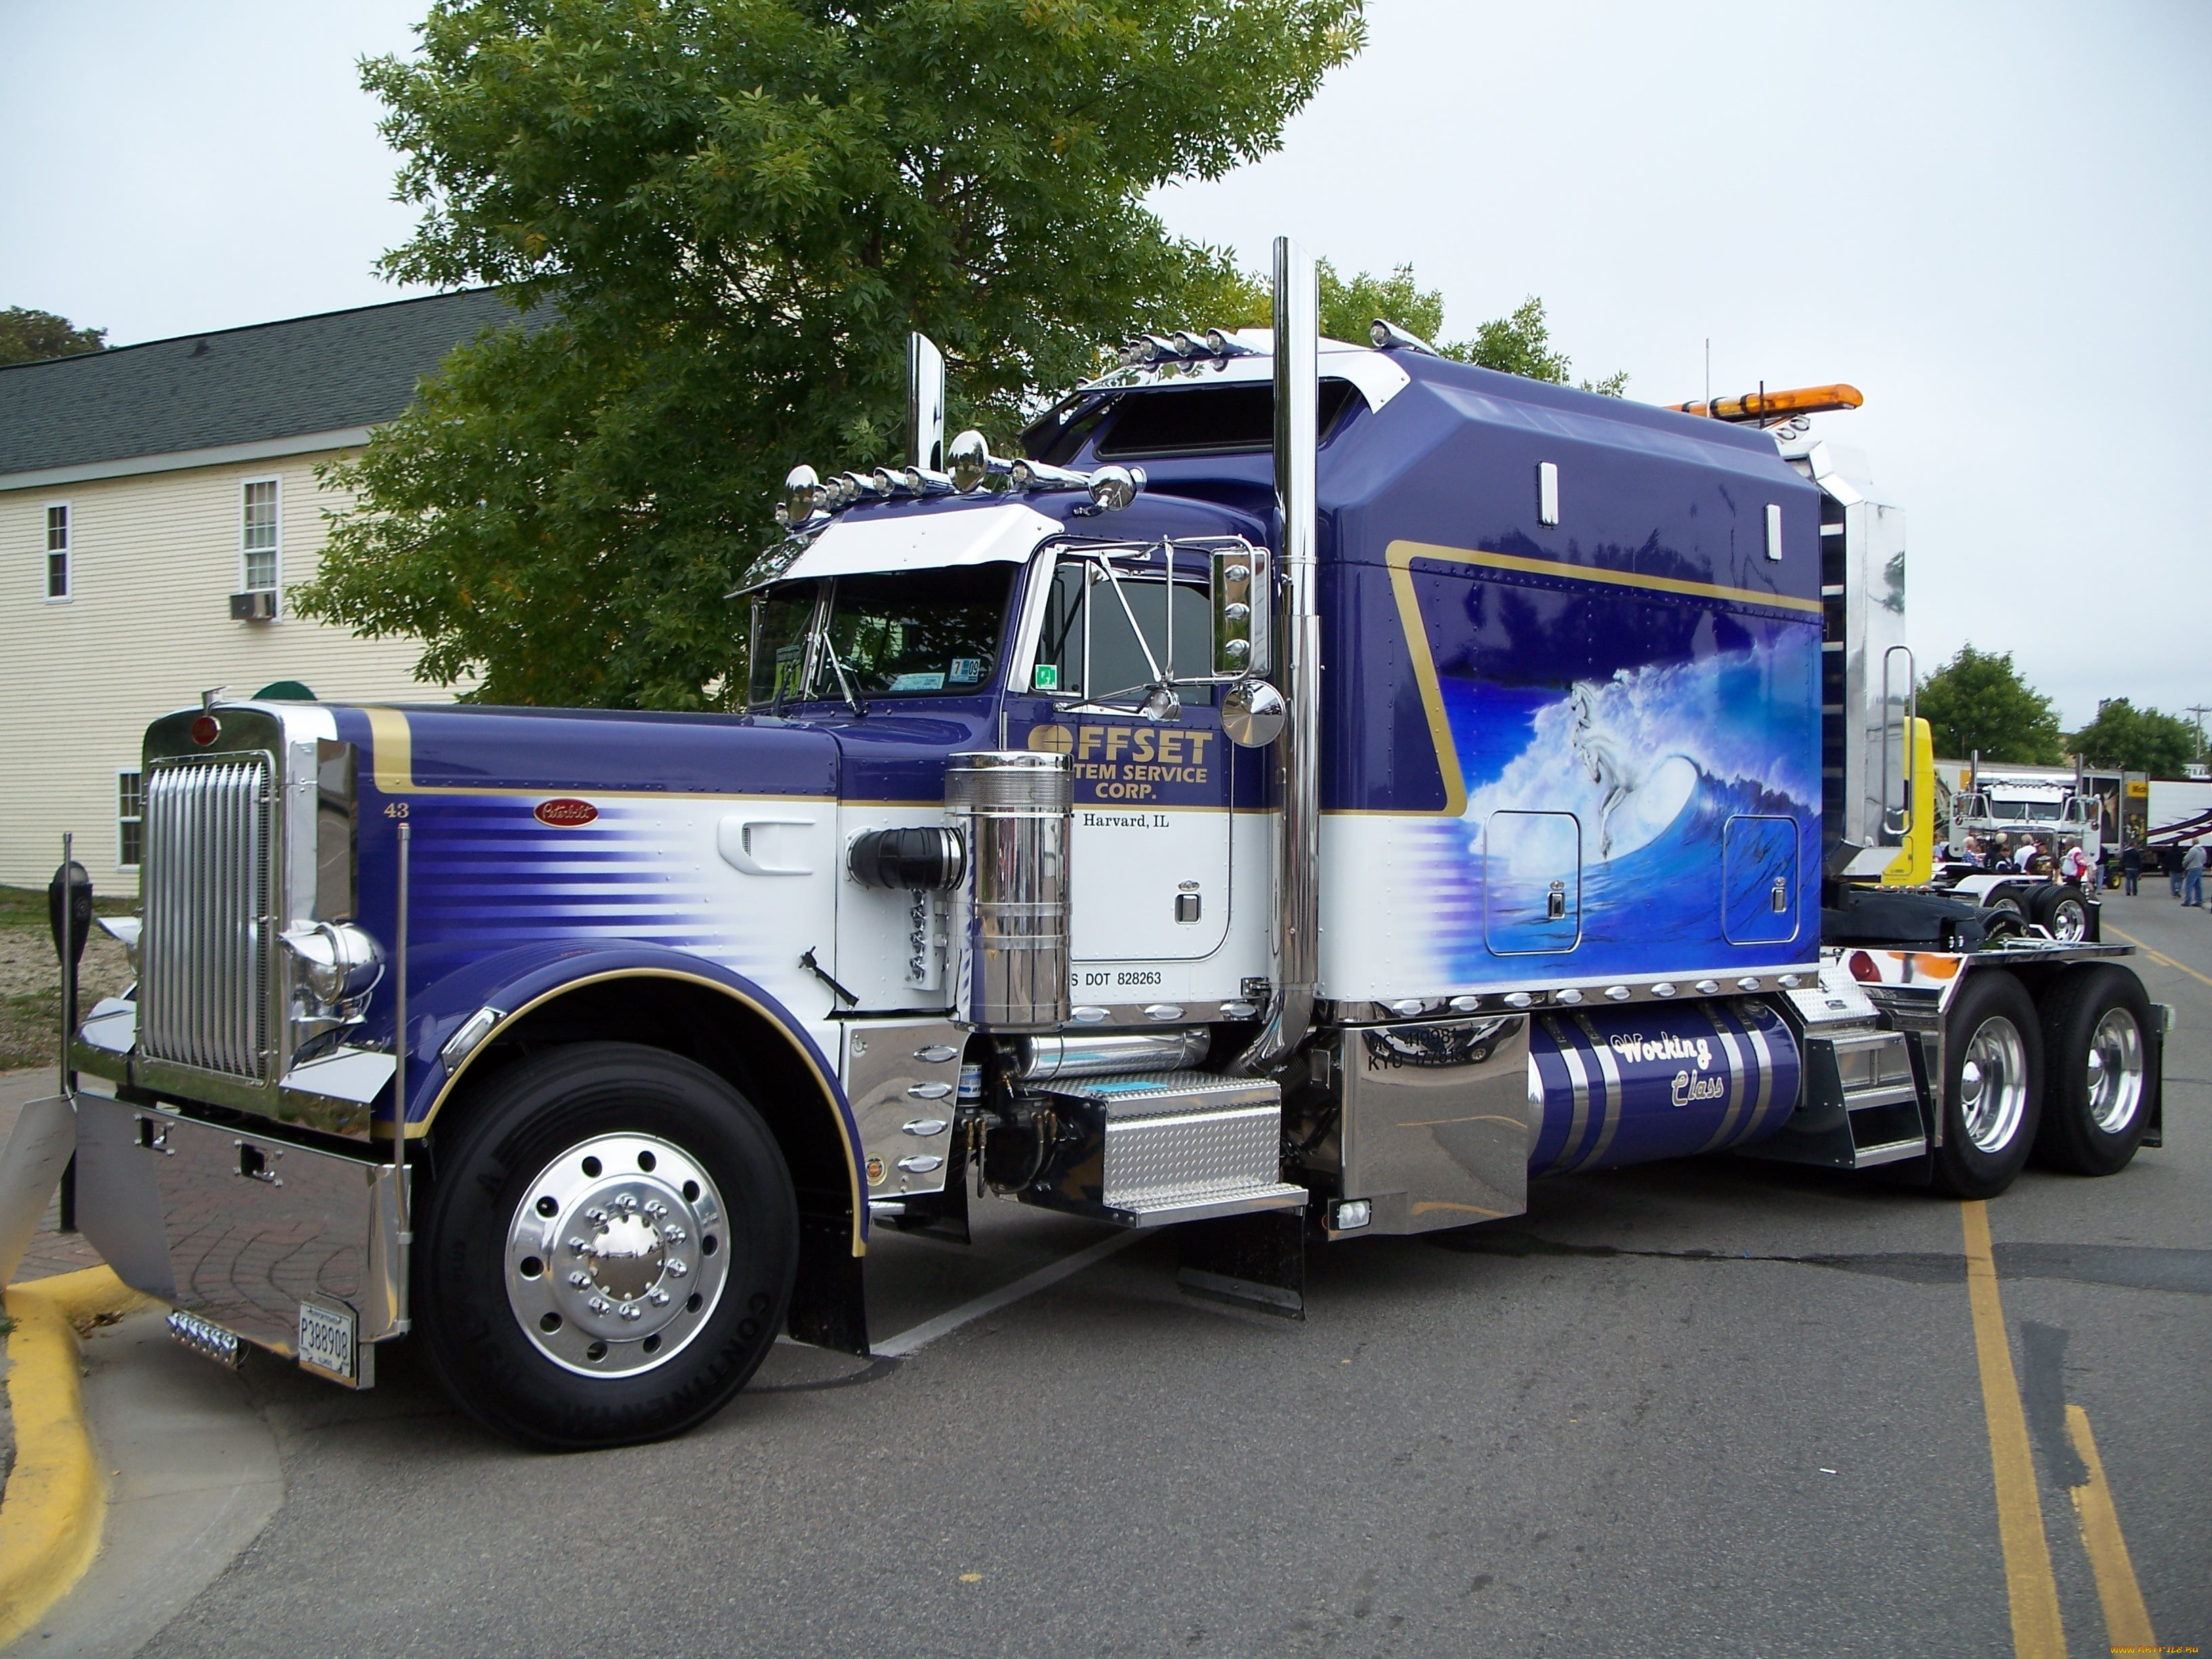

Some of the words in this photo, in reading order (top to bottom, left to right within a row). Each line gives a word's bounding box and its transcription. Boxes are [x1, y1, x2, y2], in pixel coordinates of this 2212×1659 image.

[954, 661, 961, 674] 7
[968, 661, 979, 676] 09
[1027, 724, 1213, 764] OFFSET
[1073, 763, 1116, 779] TEM
[1123, 764, 1208, 783] SERVICE
[1095, 782, 1157, 800] CORP.
[384, 802, 409, 819] 43
[542, 802, 594, 819] Peterbilt
[1083, 813, 1149, 829] Harvard,
[1153, 815, 1169, 827] IL
[1071, 973, 1078, 986] S
[1086, 973, 1111, 985] DOT
[1117, 972, 1161, 985] 828263
[1404, 1027, 1456, 1048] 419981
[1610, 1031, 1712, 1069] Working
[1368, 1053, 1402, 1071] KYU
[1671, 1069, 1723, 1107] Class
[300, 1317, 348, 1359] P388908
